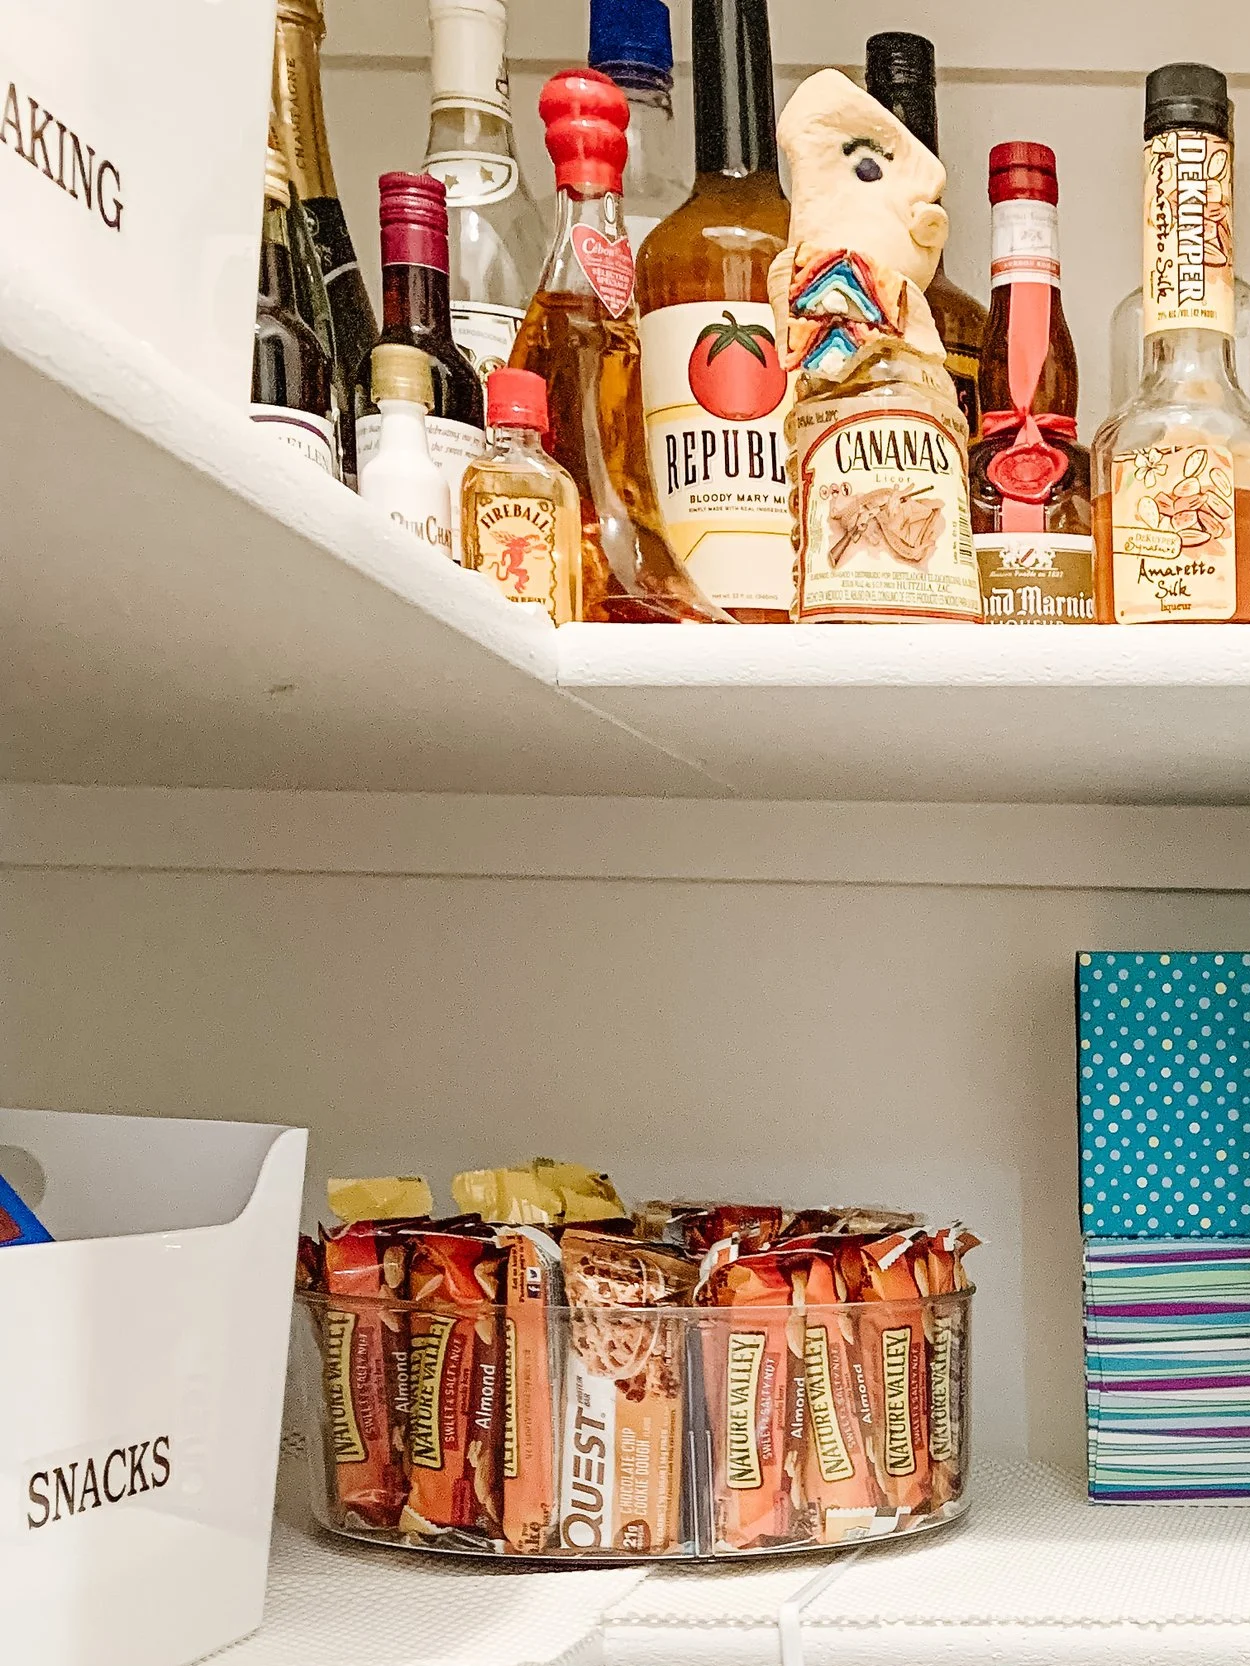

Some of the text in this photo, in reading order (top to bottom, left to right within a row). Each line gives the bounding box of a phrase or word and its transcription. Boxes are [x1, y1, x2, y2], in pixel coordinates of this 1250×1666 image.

[1151, 153, 1175, 304] Amaretto Silk
[665, 429, 787, 495] REPUBL
[835, 430, 949, 475] CANANAS
[480, 504, 550, 533] FIREBALL
[689, 493, 732, 504] BLOODY
[737, 494, 769, 503] MARY
[1137, 558, 1216, 584] Amaretto
[1155, 578, 1192, 598] Silk
[392, 1351, 410, 1413] Almond
[444, 1406, 455, 1442] SWEET
[452, 1338, 462, 1360] NUT
[763, 1358, 776, 1380] NUT
[832, 1349, 840, 1369] NUT
[414, 1386, 437, 1461] NATURE
[475, 1364, 496, 1429] Almond
[729, 1339, 760, 1481] NATURE VALLEY
[759, 1382, 772, 1415] SALTY
[791, 1377, 805, 1438] Almond
[806, 1332, 848, 1474] NATURE VALLEY
[853, 1363, 873, 1424] Almond
[886, 1333, 911, 1469] NATURE VALLEY
[619, 1427, 636, 1514] CHOCOLATE CHIP
[759, 1424, 773, 1460] SWEET
[27, 1435, 171, 1530] SNACKS
[562, 1407, 605, 1548] QUEST
[634, 1440, 651, 1516] COOKIE DOUGH
[623, 1525, 638, 1548] 21g
